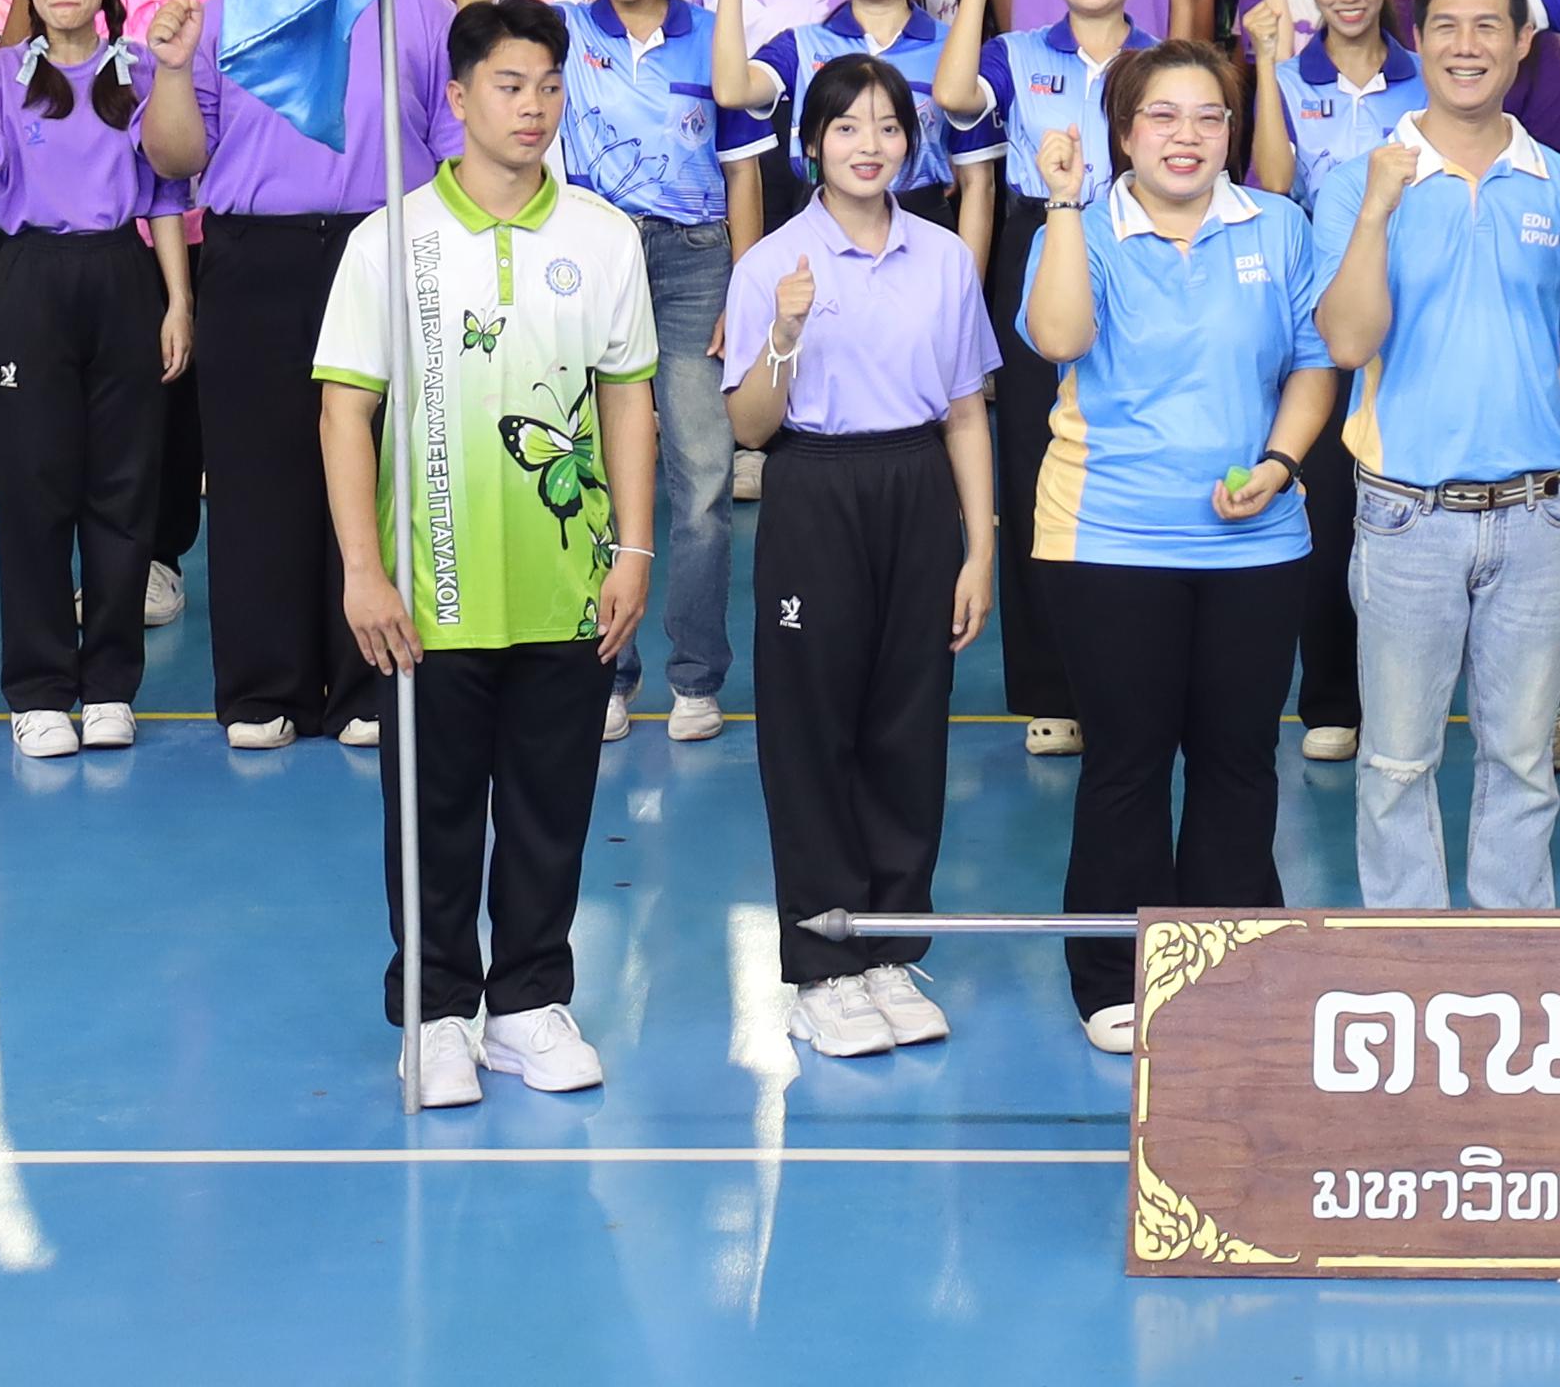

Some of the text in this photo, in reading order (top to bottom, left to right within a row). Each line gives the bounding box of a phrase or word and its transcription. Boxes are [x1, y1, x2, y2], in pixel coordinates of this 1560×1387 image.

[1522, 212, 1551, 229] EDU
[1521, 229, 1560, 247] KPRU
[1236, 252, 1264, 270] EDU
[1238, 268, 1272, 284] KPR
